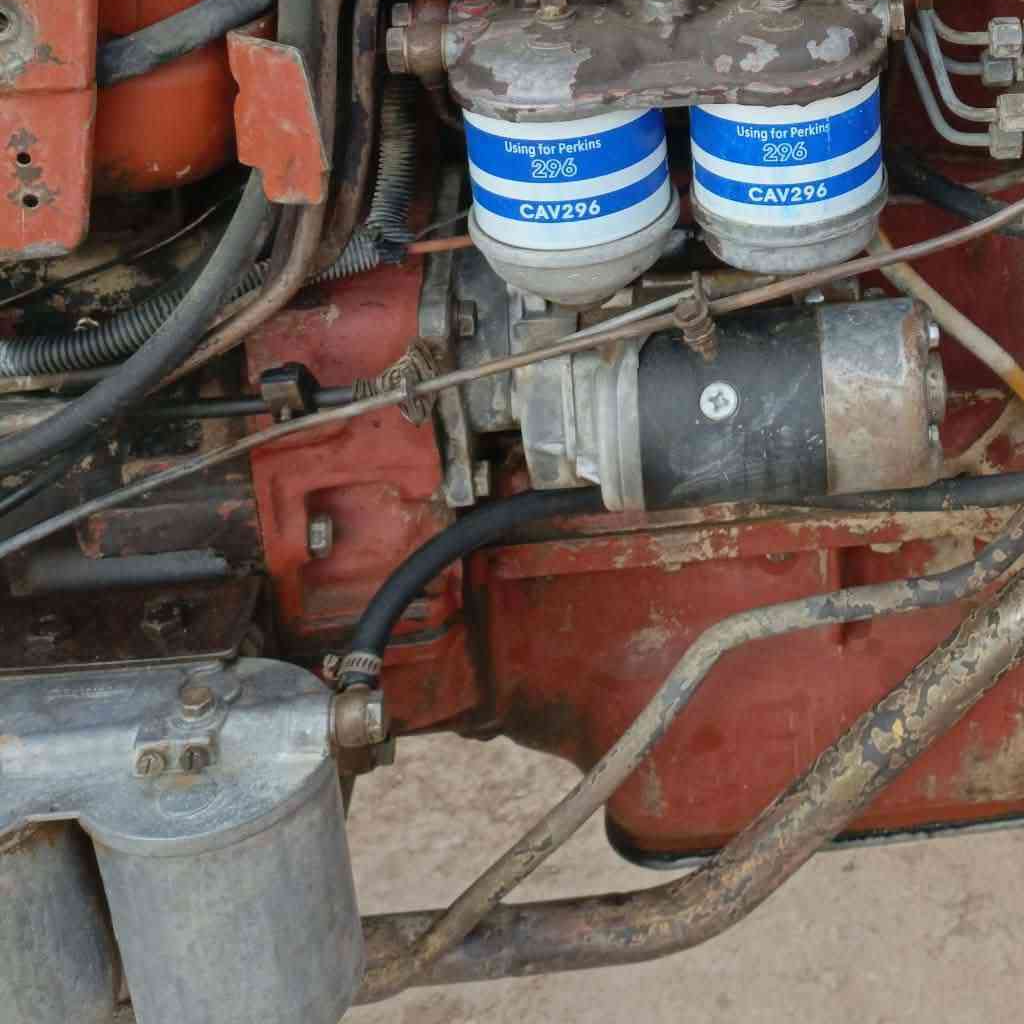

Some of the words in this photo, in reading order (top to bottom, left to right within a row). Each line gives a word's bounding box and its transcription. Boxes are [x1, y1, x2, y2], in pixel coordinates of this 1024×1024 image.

[736, 125, 768, 142] Using
[771, 127, 788, 139] for
[790, 123, 831, 138] Perkins
[504, 140, 536, 157] Using
[538, 143, 556, 155] for
[559, 139, 602, 154] Perkins
[762, 141, 808, 162] 296
[531, 157, 578, 179] 296
[748, 182, 828, 203] CAV296
[519, 199, 601, 220] CAV296
